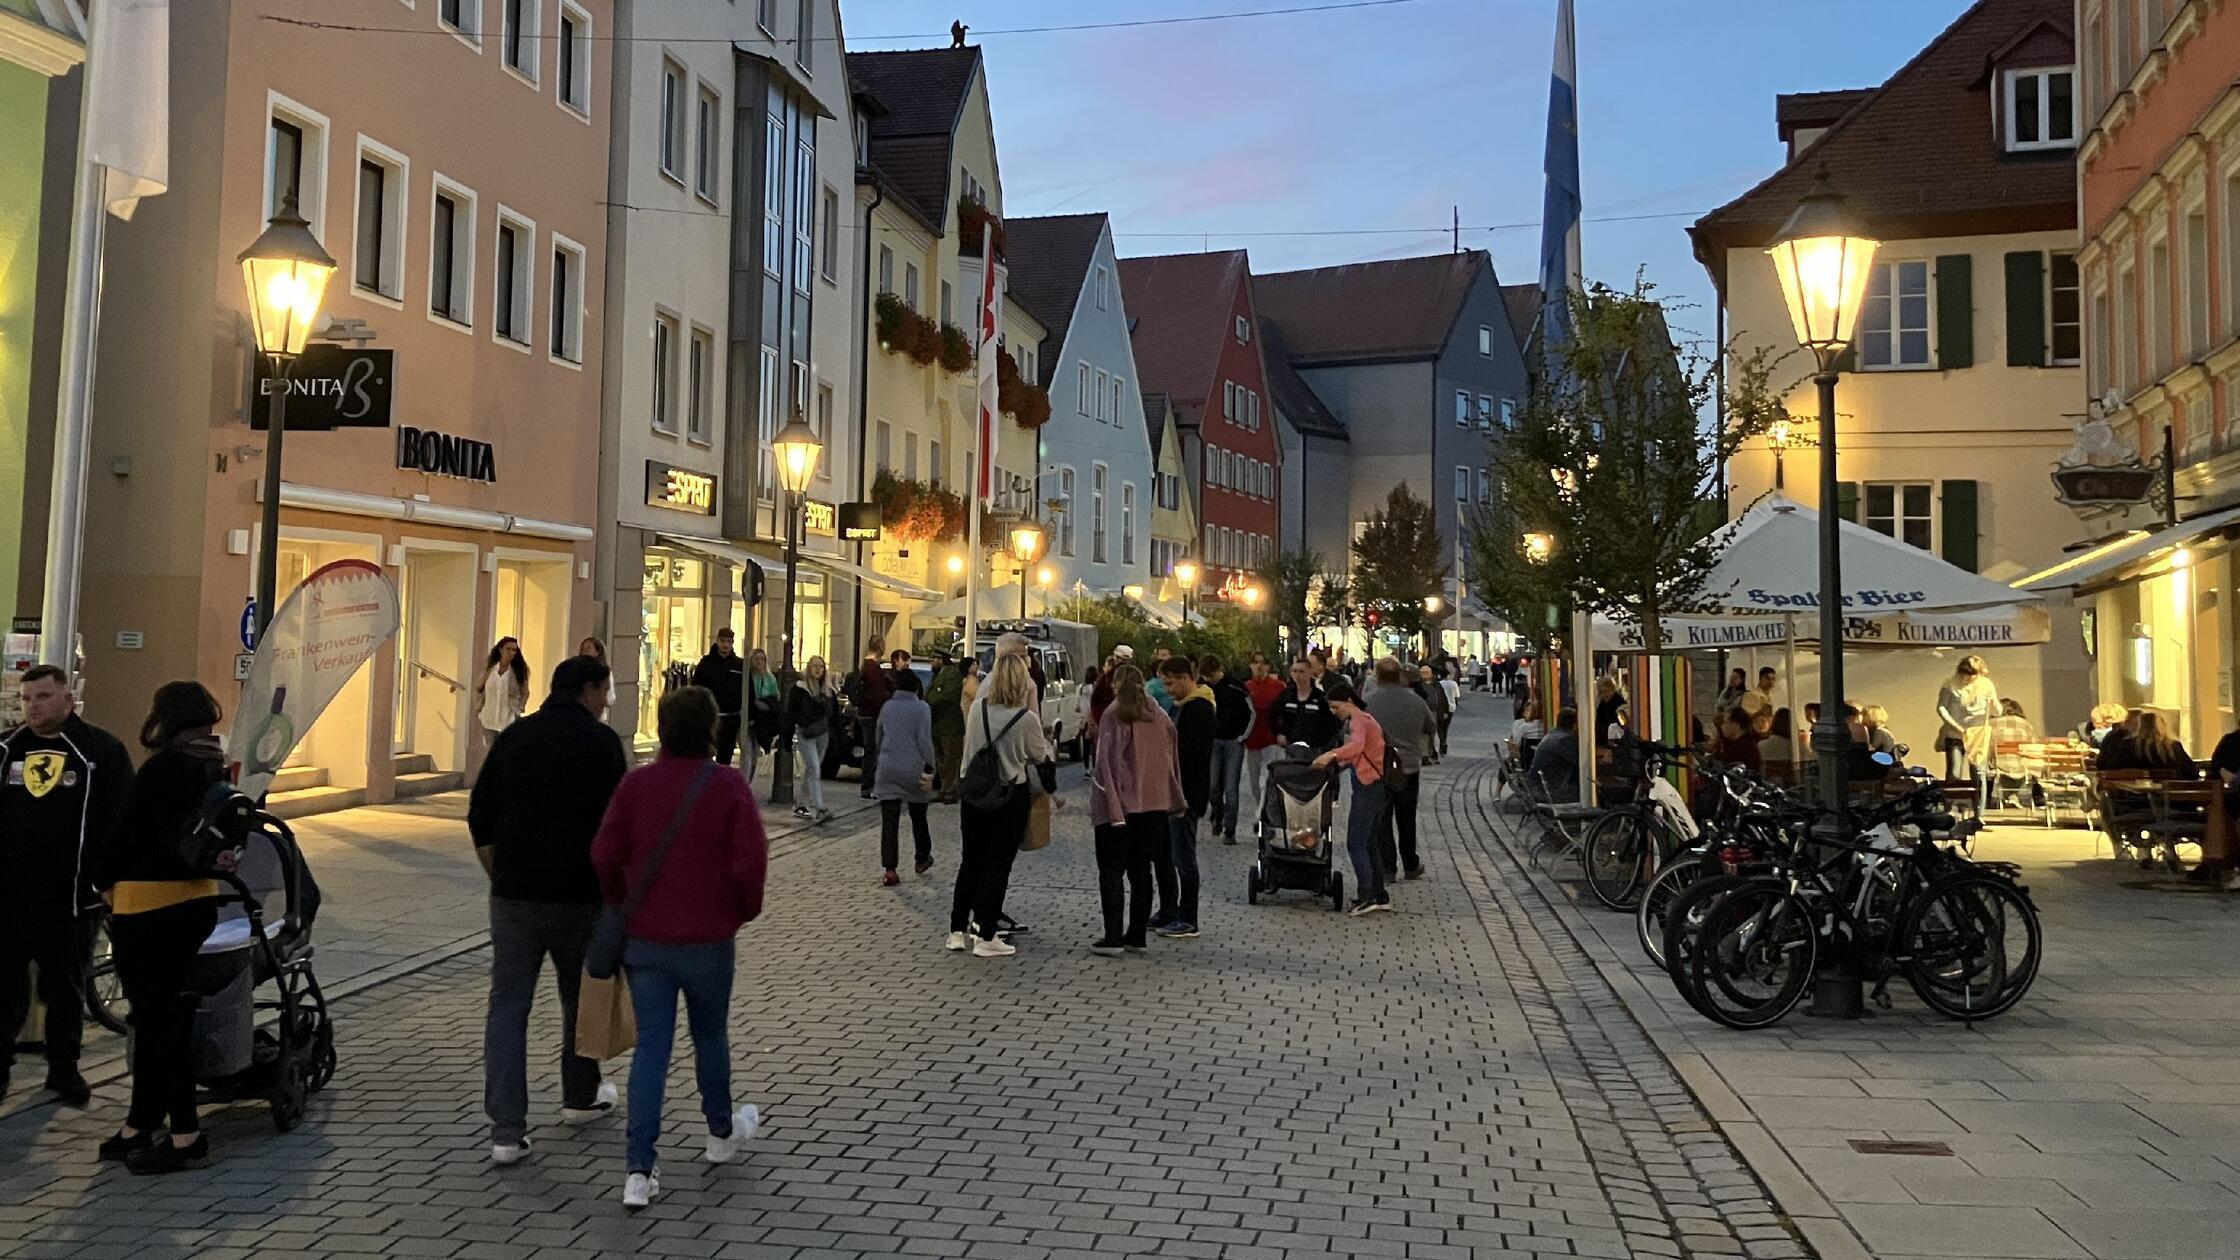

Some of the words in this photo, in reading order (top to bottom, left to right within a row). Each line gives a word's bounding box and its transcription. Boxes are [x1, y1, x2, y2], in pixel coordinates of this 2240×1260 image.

[397, 424, 496, 483] BONITA
[667, 470, 713, 508] ESPRIT
[1747, 589, 1853, 607] Spalr
[1856, 589, 1926, 607] Bier
[1897, 621, 2013, 642] KULMBACHER
[272, 633, 377, 662] Frankenwein-
